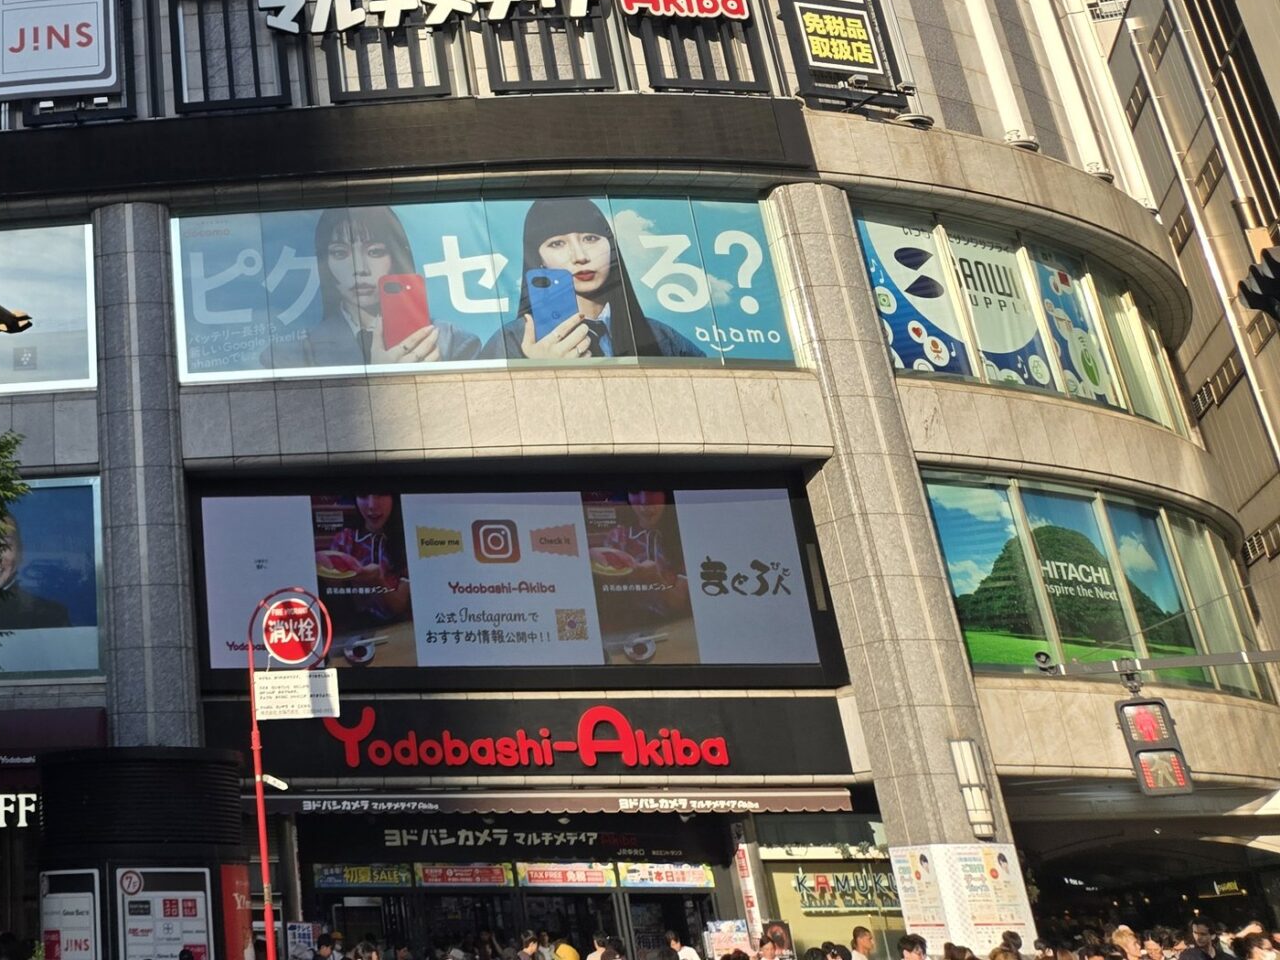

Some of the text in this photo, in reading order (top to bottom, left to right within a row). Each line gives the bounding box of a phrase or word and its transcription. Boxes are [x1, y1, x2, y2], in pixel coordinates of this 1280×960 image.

[696, 328, 781, 344] ahamo
[421, 538, 445, 546] Follow
[448, 581, 555, 594] Yodobashi-Akiba
[1077, 585, 1094, 598] the
[268, 618, 316, 644] 消火栓
[324, 705, 729, 769] Yodobashi-Akiba
[384, 829, 509, 846] ヨドバシカメラ
[513, 832, 598, 846] マルチメディア
